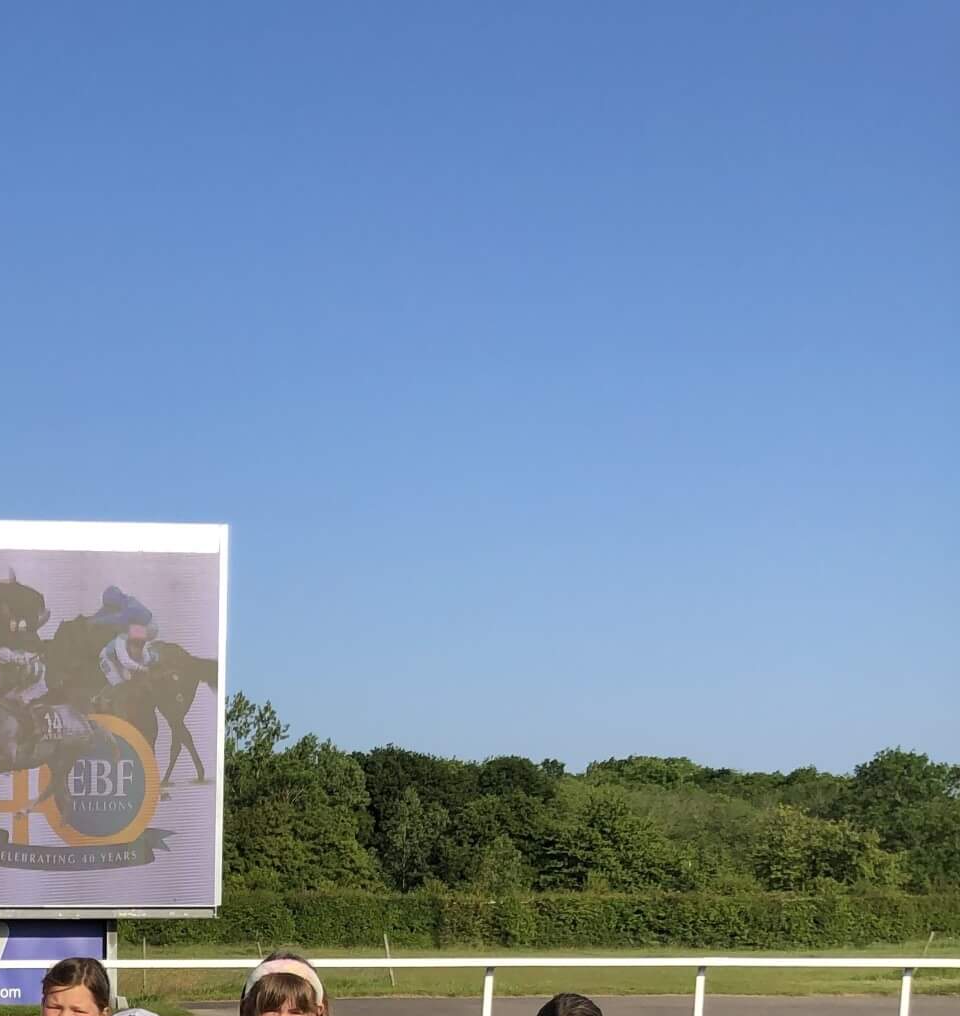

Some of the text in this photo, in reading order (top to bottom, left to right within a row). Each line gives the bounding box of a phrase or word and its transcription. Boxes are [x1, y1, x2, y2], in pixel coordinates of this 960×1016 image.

[67, 759, 135, 798] EBF
[71, 799, 135, 812] TALLIONS
[100, 850, 138, 863] YEARS
